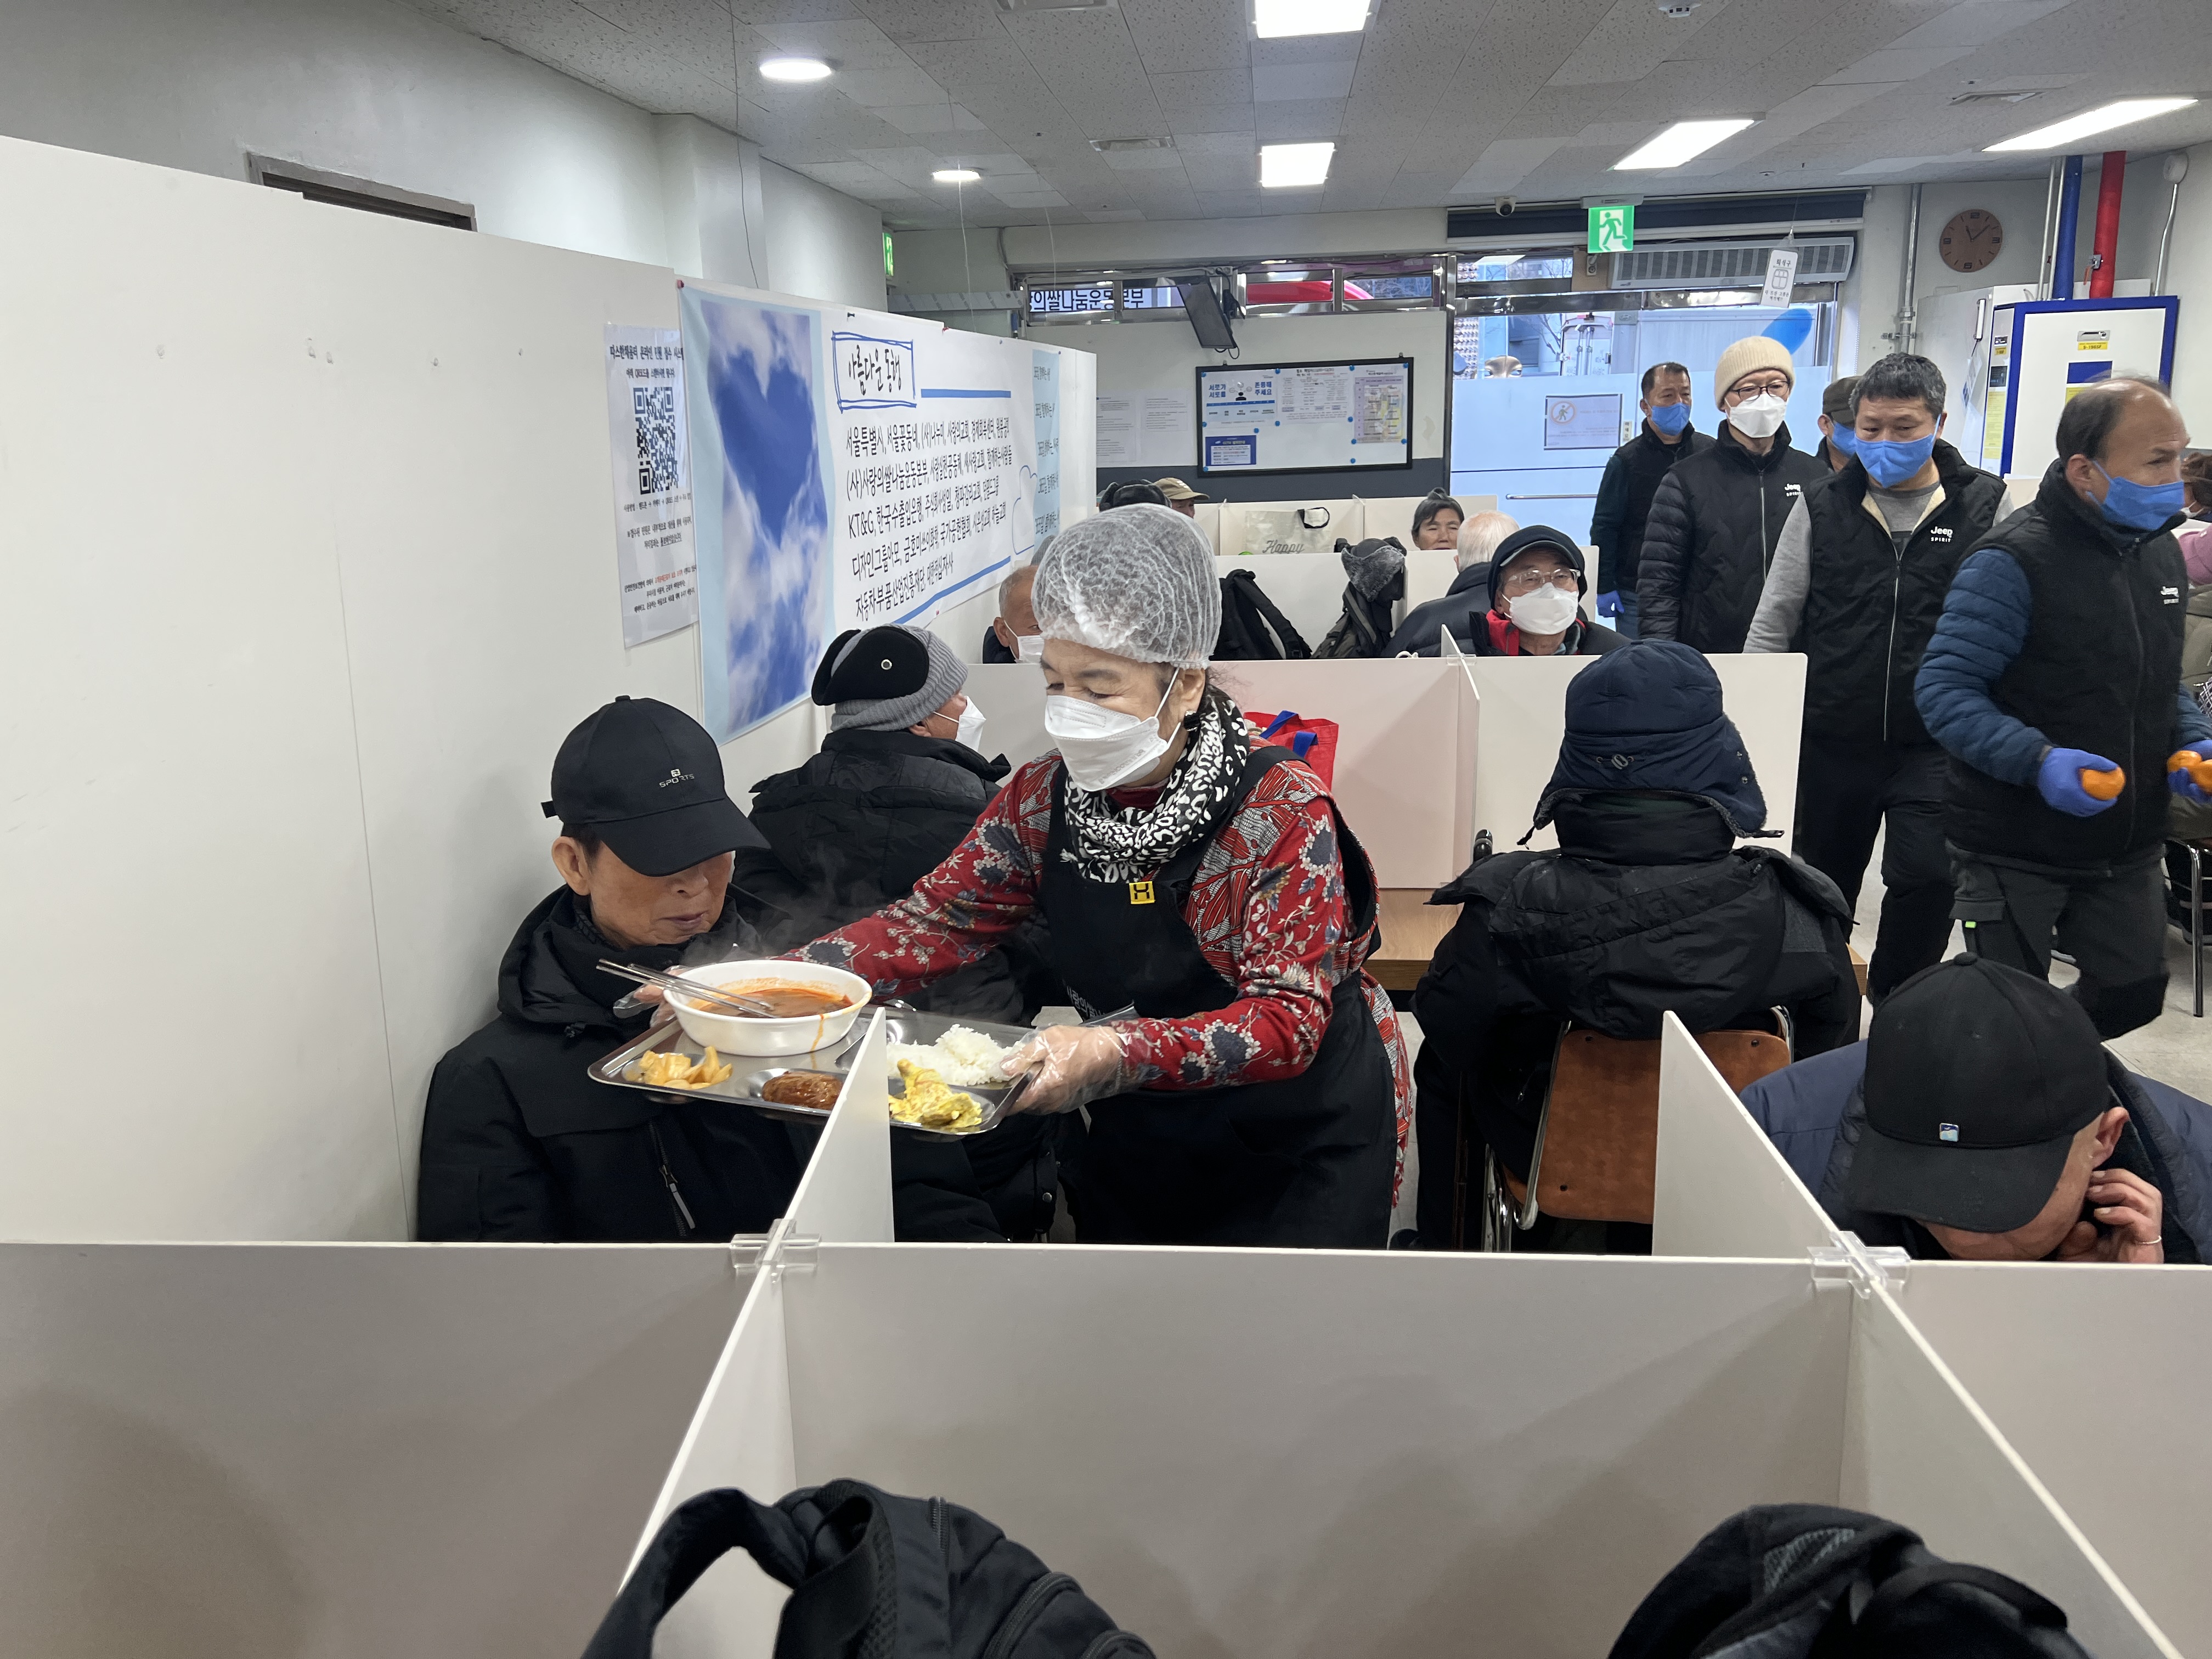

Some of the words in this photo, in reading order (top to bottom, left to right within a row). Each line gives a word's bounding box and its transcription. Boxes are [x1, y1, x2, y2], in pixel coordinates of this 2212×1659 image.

[848, 344, 884, 396] 아름다운
[884, 348, 902, 393] 동행
[847, 426, 887, 458] 서울특별시,
[887, 422, 920, 453] 서울꽃동네,
[947, 419, 970, 445] 사랑의교회,
[847, 459, 929, 501] (사)사랑의쌀나눔운동본부,
[930, 452, 964, 482] 사랑실천공동체,
[848, 510, 876, 539] KT&G,
[876, 495, 924, 534] 한국수출입은행,
[1930, 526, 1953, 538] Jeep
[851, 541, 902, 582] 디자인그룹아모,
[1262, 539, 1305, 554] Happy
[855, 566, 926, 622] 자동차부품산업진흥재단,
[927, 551, 953, 585] 대한적십자사
[659, 774, 695, 788] SPORTS
